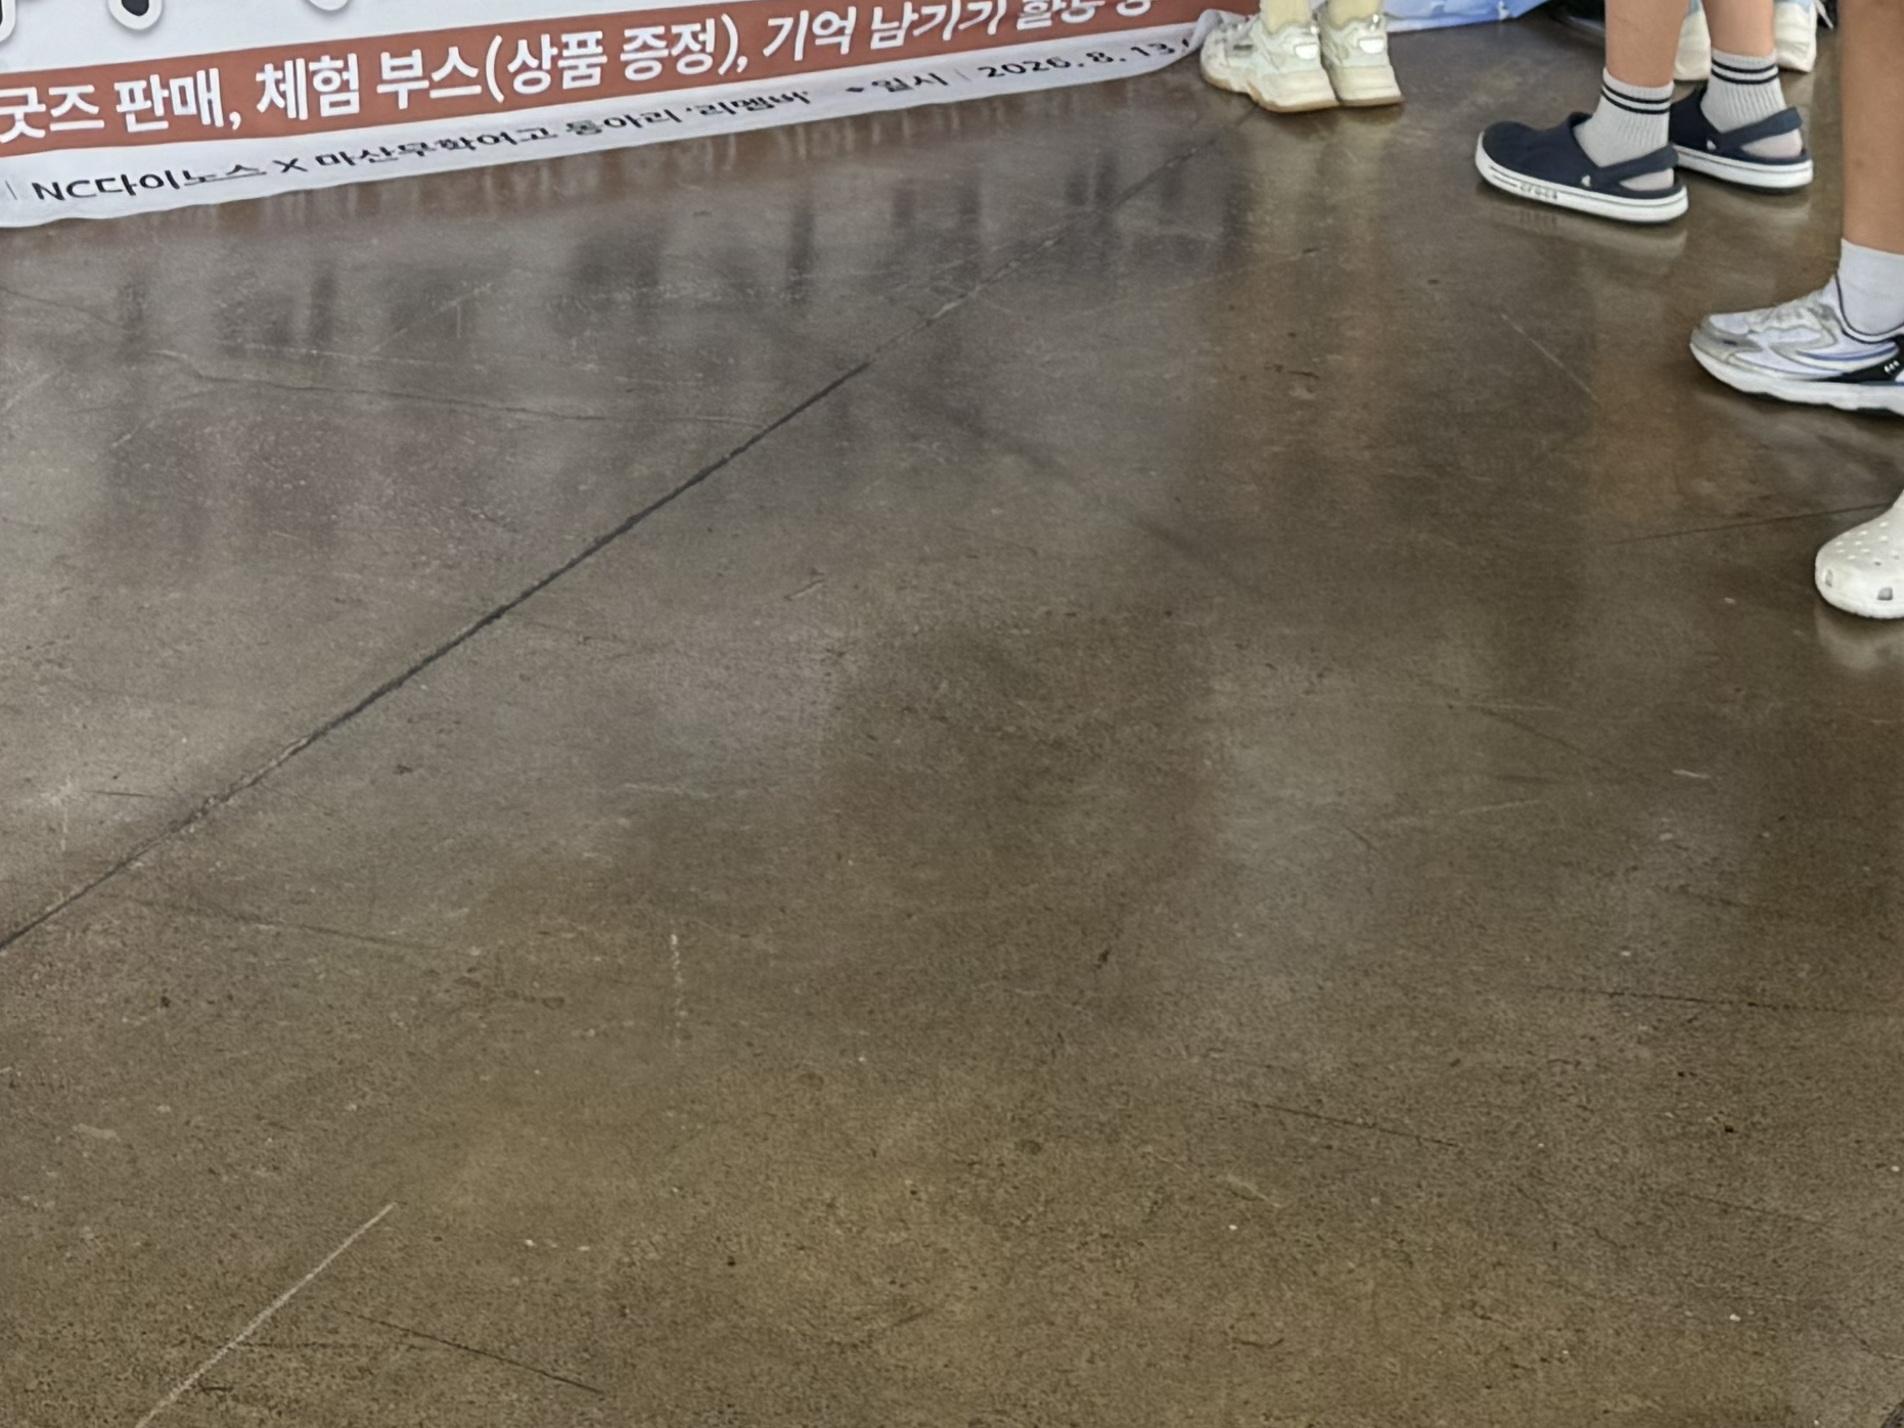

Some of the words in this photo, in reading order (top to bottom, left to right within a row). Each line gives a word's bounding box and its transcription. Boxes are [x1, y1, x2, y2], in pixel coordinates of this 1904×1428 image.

[115, 69, 241, 132] 판매,
[255, 53, 360, 121] 체험
[376, 28, 606, 110] 부스(상품
[622, 12, 748, 78] 증정),
[763, 1, 857, 64] 기억
[31, 160, 267, 202] NC다이노스
[566, 108, 682, 137] 동아리
